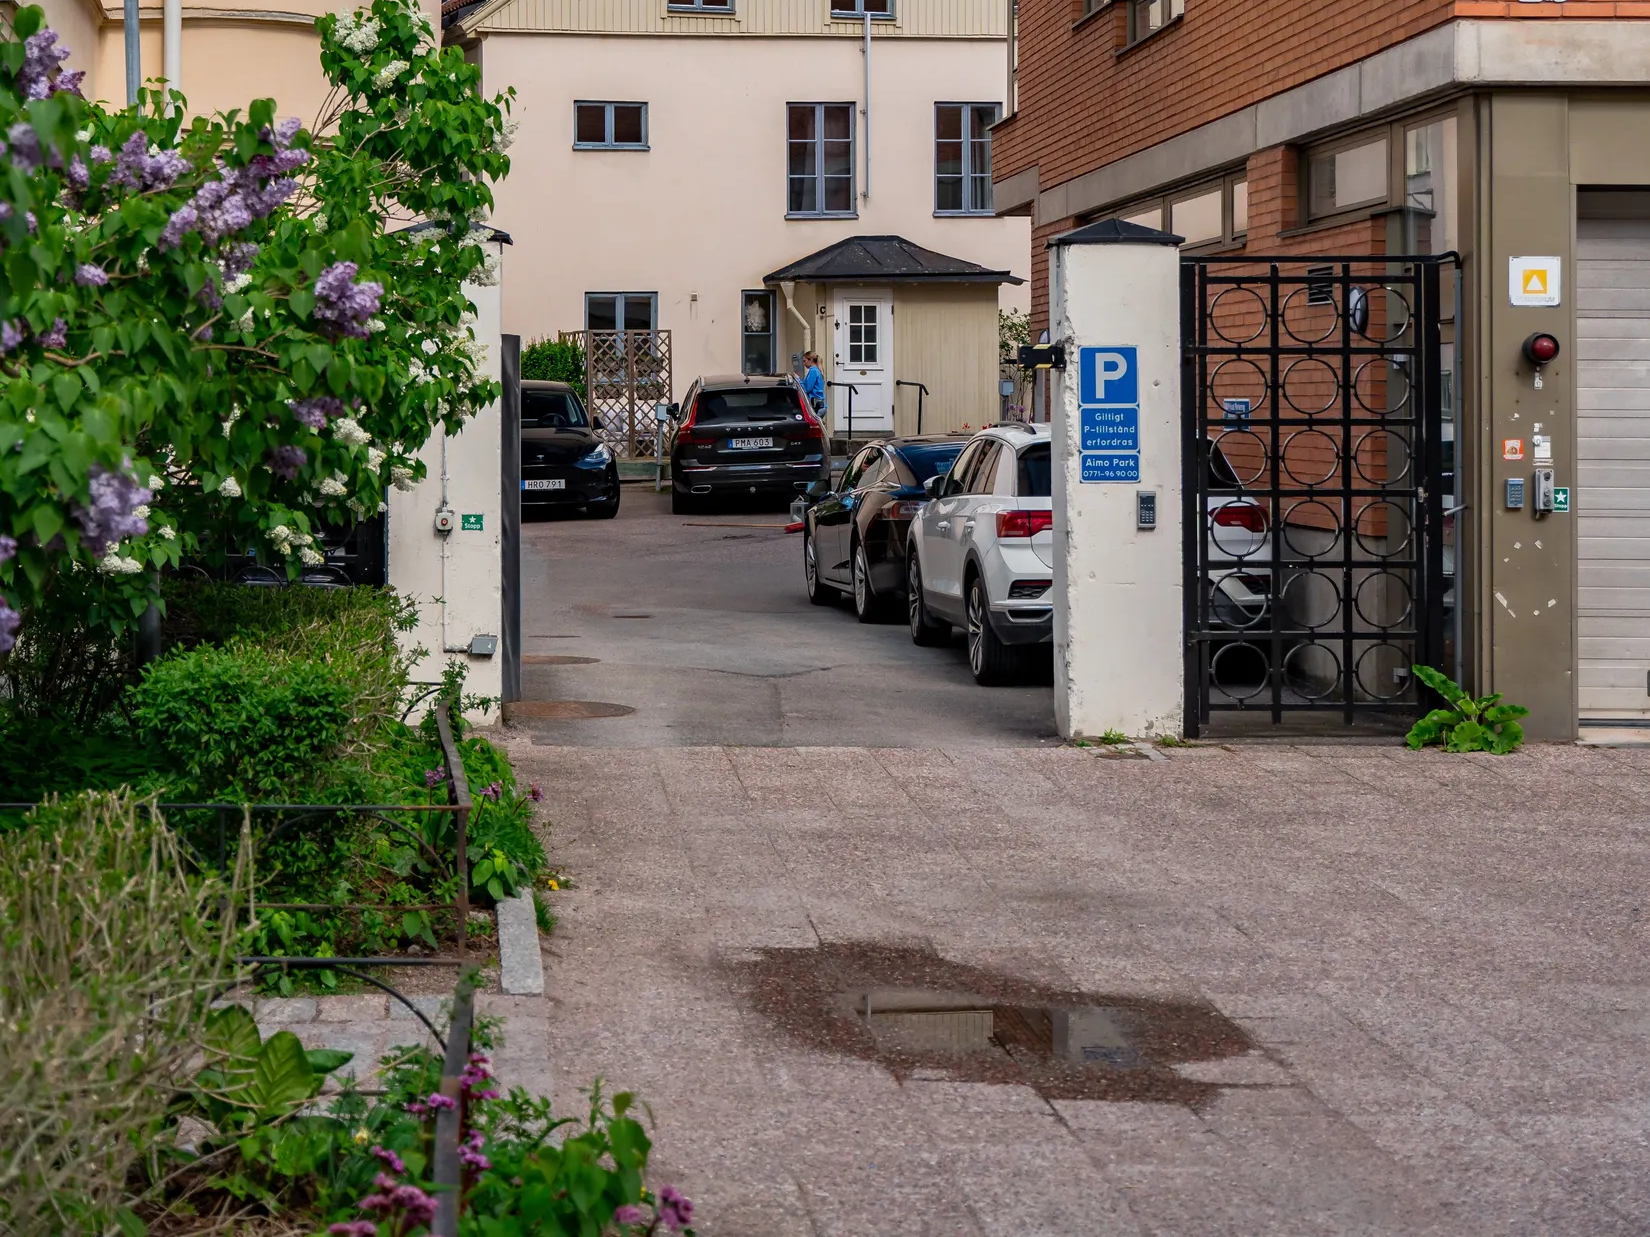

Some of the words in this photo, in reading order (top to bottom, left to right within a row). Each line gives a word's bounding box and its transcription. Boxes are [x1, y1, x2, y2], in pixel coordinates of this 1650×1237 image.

[1095, 352, 1128, 399] P
[1095, 412, 1124, 422] Giltigt
[1084, 425, 1135, 434] P-tillstånd
[735, 438, 752, 447] PMA
[753, 438, 770, 447] 603
[1086, 437, 1133, 446] erfordras
[1085, 458, 1110, 467] Aimo
[1113, 458, 1135, 467] Park
[1083, 470, 1114, 478] 0771-96
[1115, 470, 1126, 478] 90
[1127, 470, 1138, 478] 00
[546, 480, 562, 488] 791
